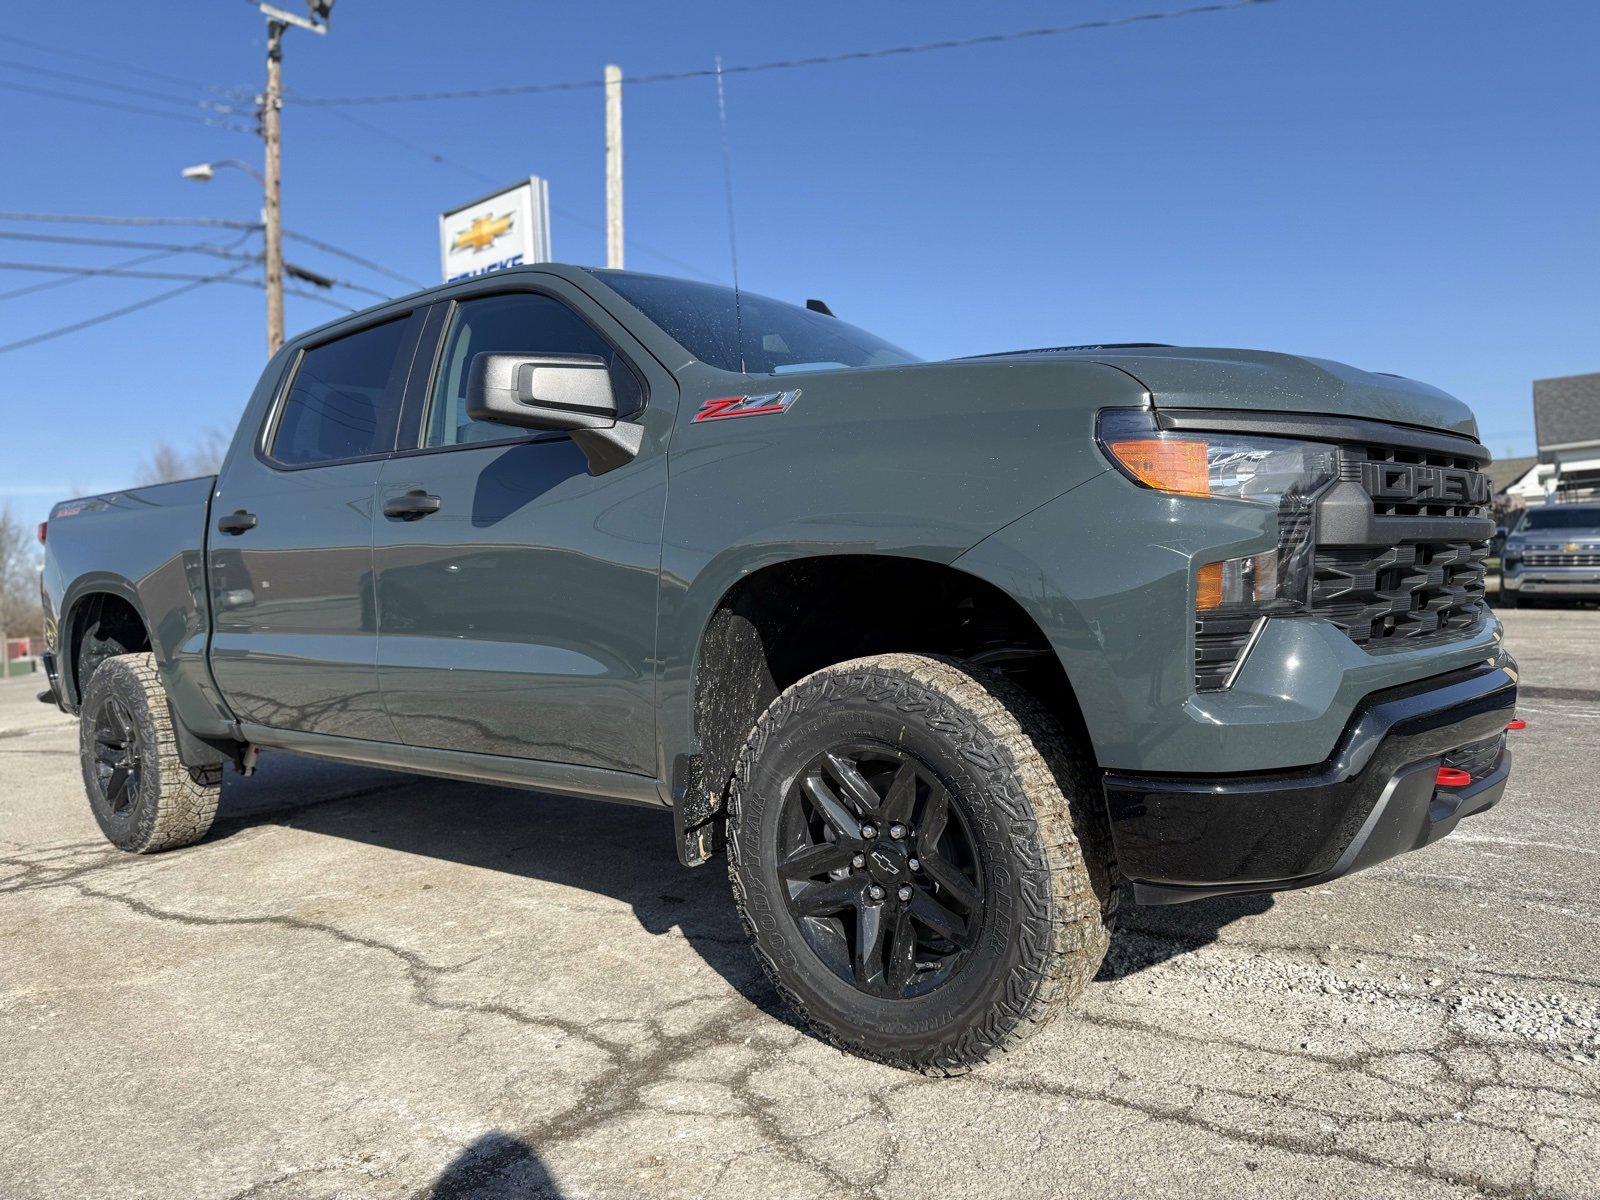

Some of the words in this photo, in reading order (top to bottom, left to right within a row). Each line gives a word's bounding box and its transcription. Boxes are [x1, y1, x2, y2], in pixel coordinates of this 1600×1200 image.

[689, 388, 802, 424] Z71
[745, 791, 799, 969] GOODYEAR
[949, 763, 1012, 955] WRANGLER
